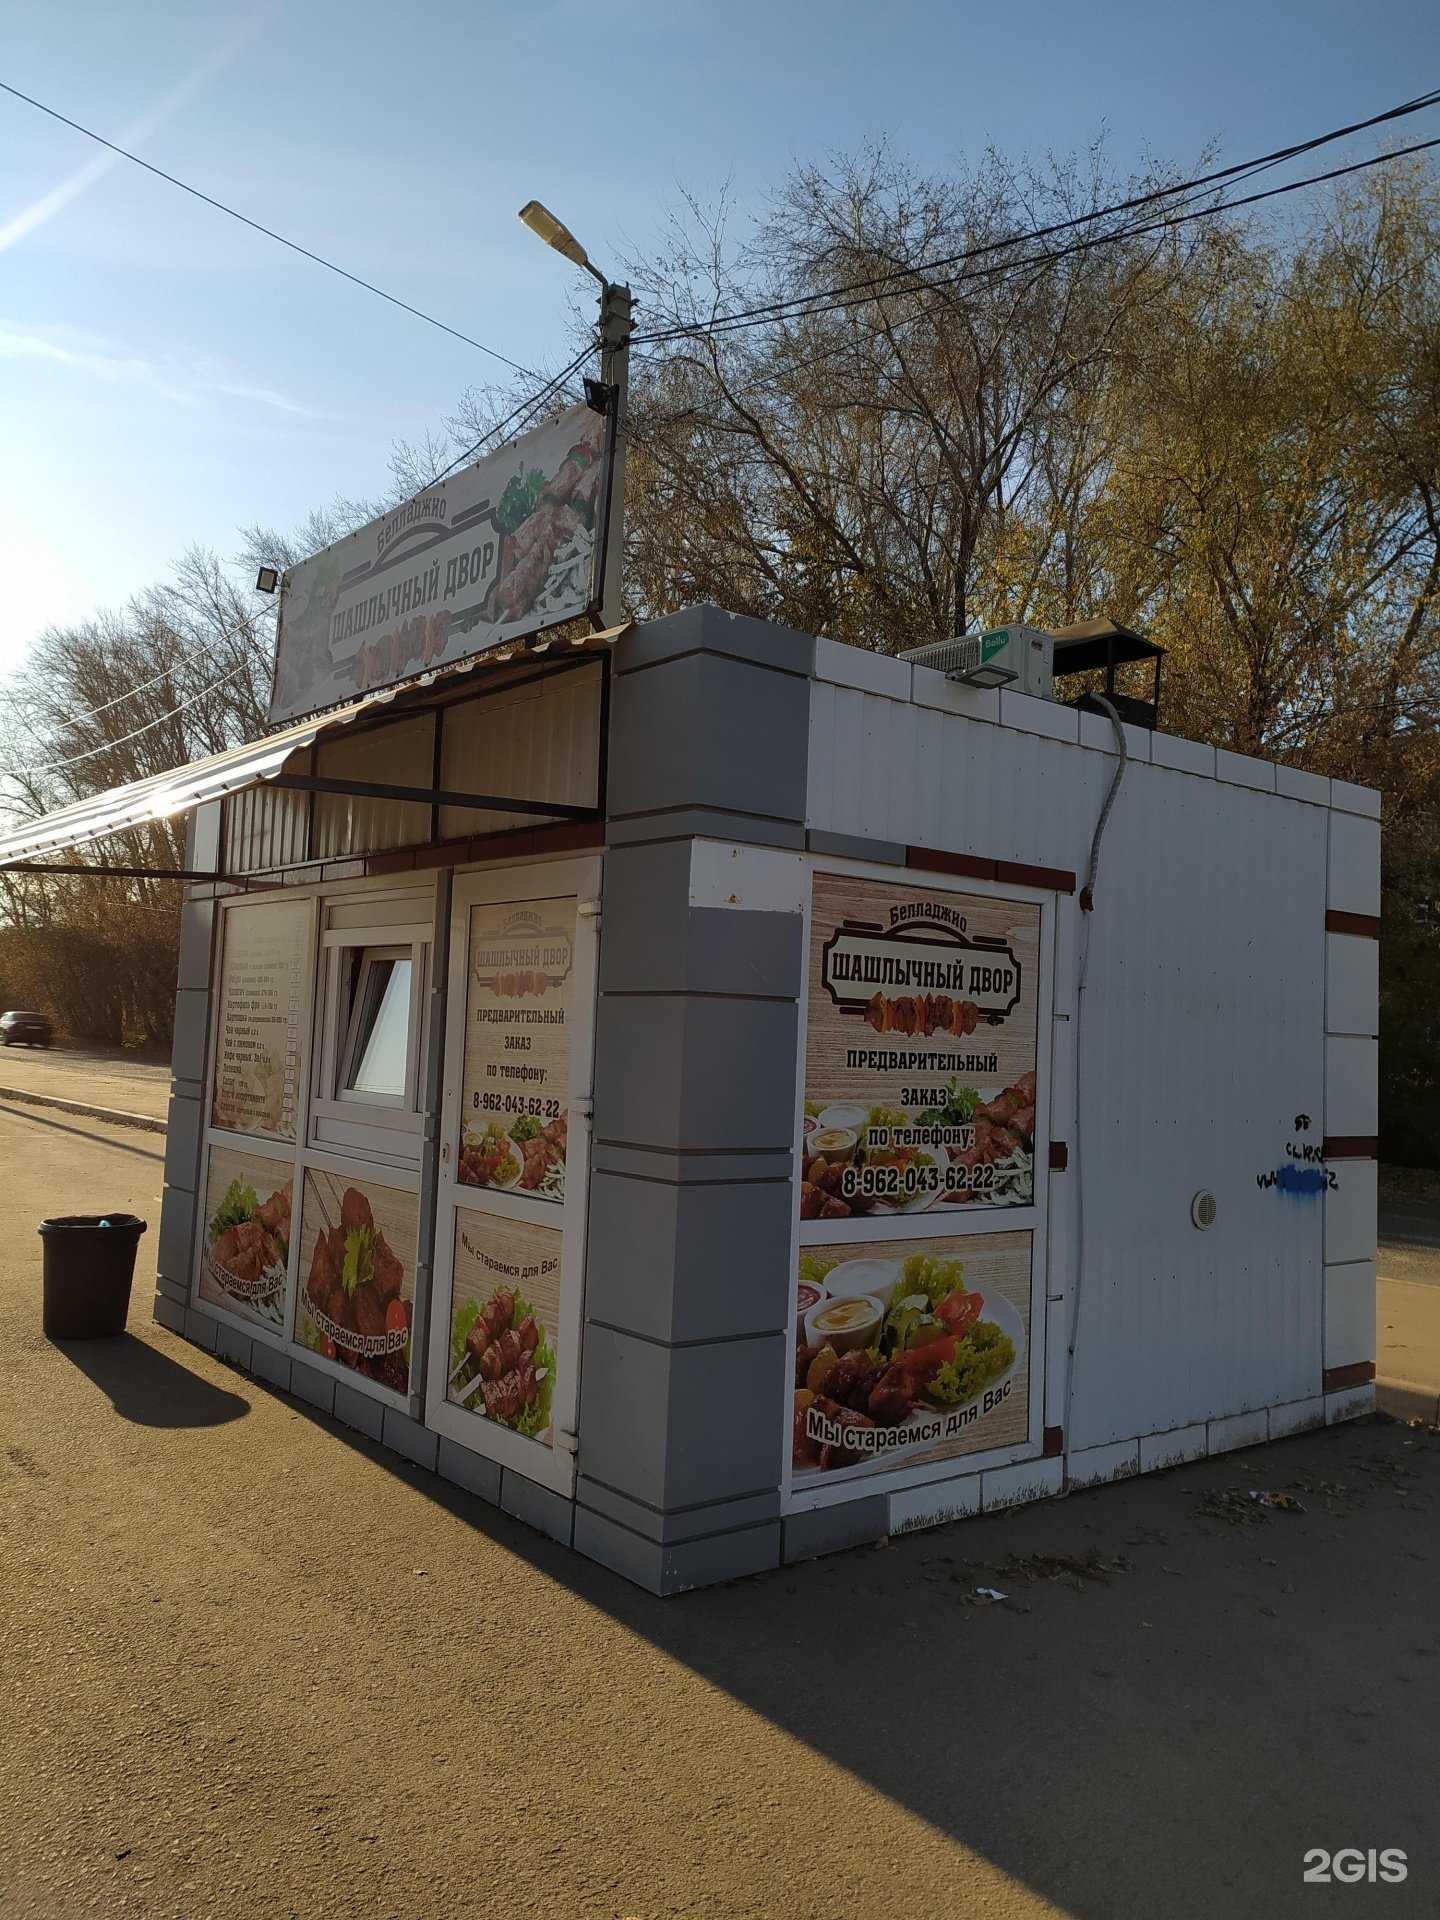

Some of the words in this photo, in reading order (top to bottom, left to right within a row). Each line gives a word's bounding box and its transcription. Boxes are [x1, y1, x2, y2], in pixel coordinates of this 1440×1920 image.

[377, 497, 447, 550] Белладжио
[332, 558, 441, 644] ШАШЛЫЧНЫЙ
[444, 541, 494, 601] ДВОР
[889, 902, 968, 933] Белладжио
[477, 946, 539, 968] ШАШЛЫЧНЫЙ
[543, 946, 568, 968] ДВОР
[831, 953, 964, 991] ШАШЛЫЧНЫЙ
[968, 969, 1014, 995] ДВОР
[476, 1008, 565, 1025] ПРЕДВАРИТЕЛЬНЫЙ
[504, 1036, 532, 1051] ЗАКАЗ
[486, 1064, 497, 1077] по
[500, 1064, 548, 1085] телефону:
[847, 1050, 998, 1073] ПРЕДВАРИТЕЛЬНЫЙ
[472, 1091, 560, 1119] 8-962-043-62-22
[901, 1087, 947, 1107] ЗАКАЗ
[868, 1128, 888, 1146] по
[893, 1124, 975, 1150] телефону:
[843, 1165, 994, 1195] 8-962-043-62-22
[462, 1232, 475, 1256] Мы
[476, 1250, 519, 1277] стараемся
[521, 1265, 539, 1279] для
[541, 1258, 558, 1275] Вас
[215, 1263, 250, 1294] стараемся
[252, 1282, 266, 1297] для
[268, 1275, 282, 1292] Вас
[316, 1314, 364, 1349] стараемся
[366, 1337, 385, 1353] для
[388, 1329, 407, 1350] Вас
[808, 1411, 840, 1442] Мы
[845, 1421, 941, 1452] стараемся
[946, 1405, 978, 1436] для
[983, 1379, 1012, 1414] Вас
